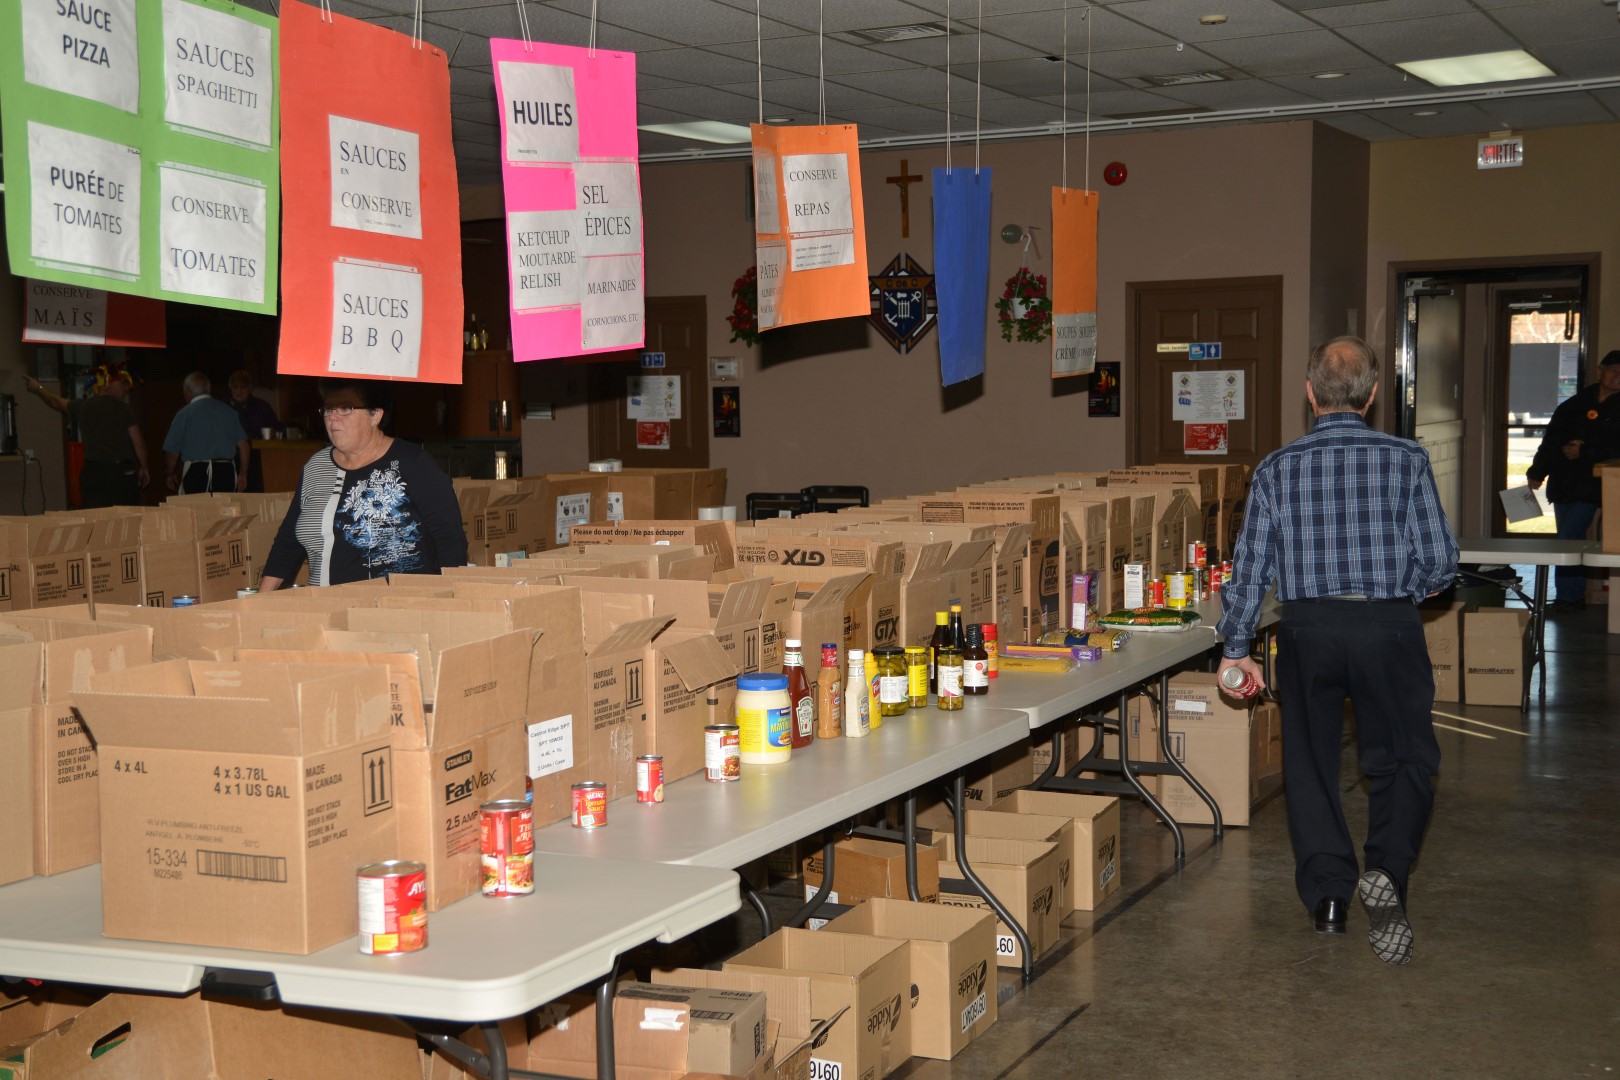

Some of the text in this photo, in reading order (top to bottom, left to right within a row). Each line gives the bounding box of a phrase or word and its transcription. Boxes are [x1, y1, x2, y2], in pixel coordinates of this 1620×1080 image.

[57, 0, 112, 33] SAUCE
[63, 34, 110, 69] PIZZA
[176, 37, 255, 78] SAUCES
[177, 74, 258, 109] SPAGHETTI
[513, 100, 573, 127] HUILES
[339, 140, 407, 172] SAUCES
[341, 167, 349, 176] EN
[789, 168, 838, 182] CONSERVE
[50, 166, 125, 203] PURÉE DE
[582, 184, 609, 205] SEL
[172, 195, 250, 226] CONSERVE
[341, 191, 412, 218] CONSERVE
[794, 201, 831, 217] REPAS
[53, 202, 123, 236] TOMATES
[585, 211, 632, 237] ÉPICES
[517, 230, 570, 247] KETCHUP
[170, 247, 257, 279] TOMATES
[519, 251, 577, 267] MOUTARDE
[759, 260, 779, 280] PÂTES
[520, 272, 561, 290] RELISH
[587, 279, 637, 295] MARINADES
[33, 285, 94, 299] CONSERVE
[343, 293, 409, 320] SAUCES
[573, 528, 593, 536] Please
[594, 528, 601, 536] do
[614, 528, 629, 537] drop
[643, 530, 655, 538] pas
[655, 528, 685, 537] échapper
[781, 549, 825, 567] GTX
[874, 616, 899, 642] GTX
[593, 667, 614, 680] FABRIQUÉ
[664, 668, 670, 676] AU
[600, 678, 617, 689] CANADA
[58, 715, 80, 726] MADE
[58, 729, 66, 738] IN
[530, 722, 570, 737] Castrol Edge SPT
[58, 748, 77, 758] DO NOT
[58, 758, 72, 767] OVER
[77, 755, 90, 763] HIGH
[58, 766, 75, 776] STORE
[114, 760, 148, 774] 4 x 4L
[213, 766, 268, 782] 4 x 3.78L
[305, 763, 325, 778] MADE
[58, 772, 85, 784] COOL DRY
[306, 773, 343, 792] IN CANADA
[445, 769, 497, 801] FatMax
[214, 782, 290, 799] 4 x 1 US GAL
[307, 800, 341, 816] DO NOT STACK
[587, 805, 605, 813] Sauce
[308, 811, 338, 827] OVER 5 HIGH
[446, 810, 479, 831] 2.5 AMP
[308, 826, 323, 838] STORE
[325, 824, 330, 832] IN
[308, 828, 348, 848] COOL DRY PLACE
[146, 847, 188, 867] 15-334
[807, 857, 815, 867] 2
[958, 969, 978, 997] Kidde
[868, 1004, 891, 1034] Kidde
